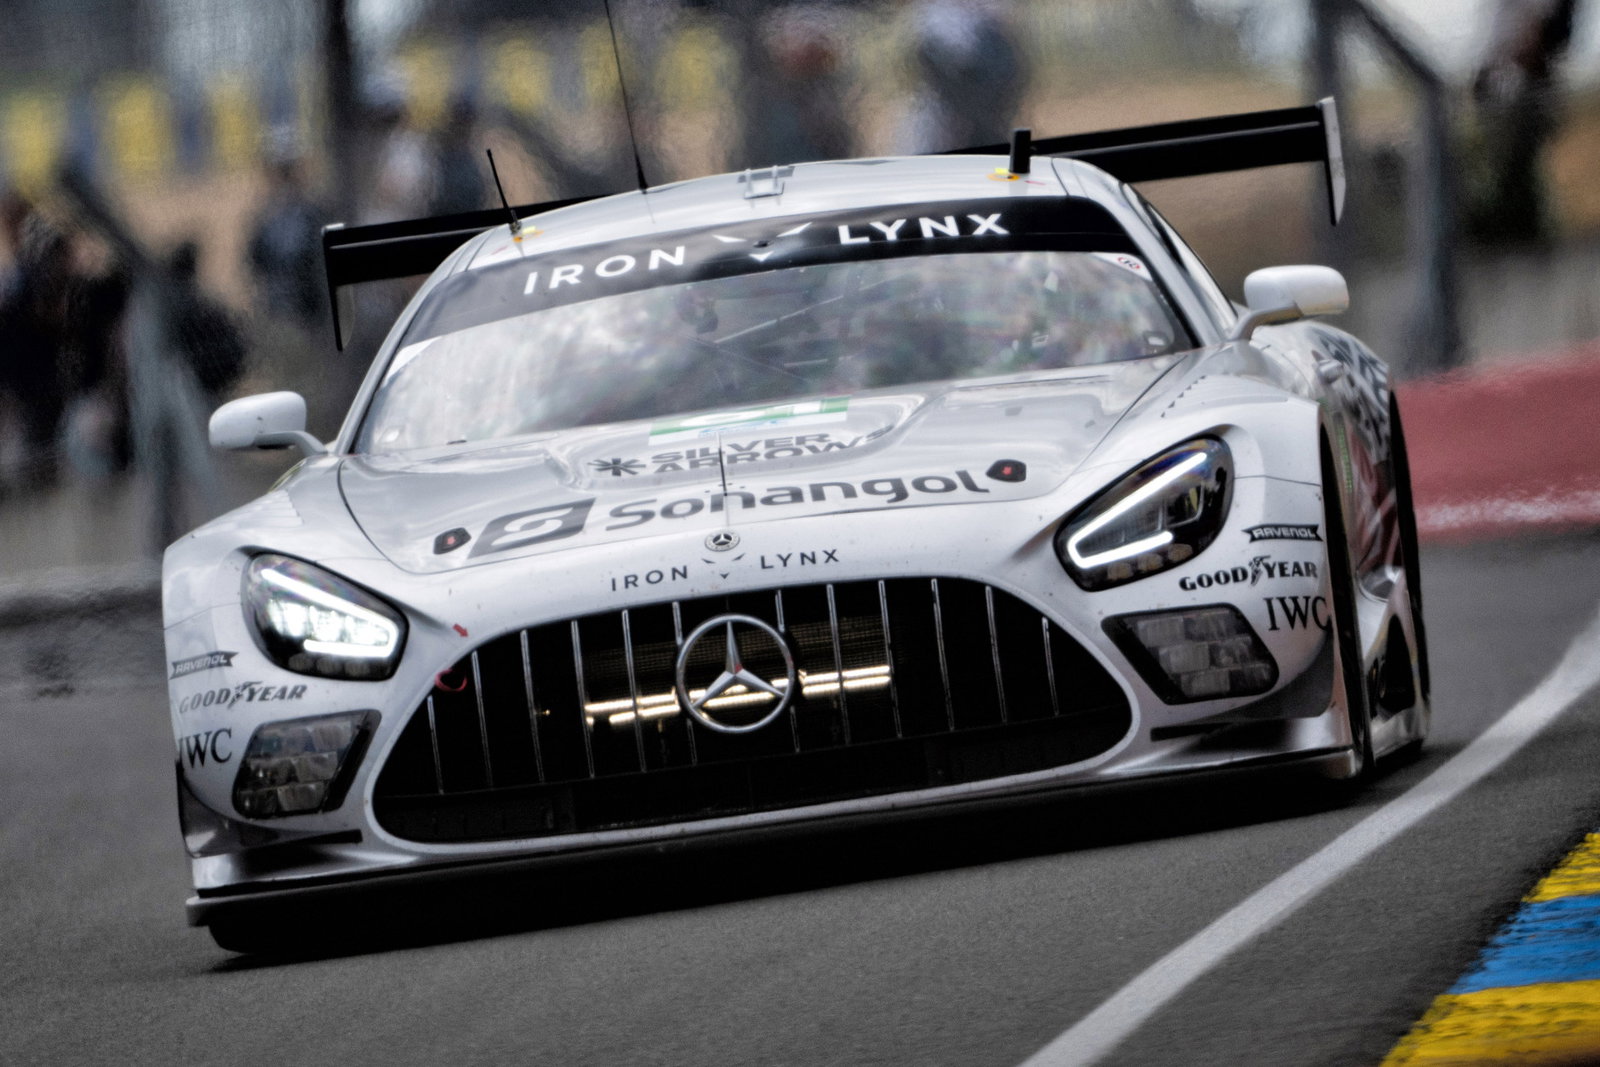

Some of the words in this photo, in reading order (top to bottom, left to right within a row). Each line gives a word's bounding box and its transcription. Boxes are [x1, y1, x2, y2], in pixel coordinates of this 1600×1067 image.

[523, 245, 686, 295] IRON
[838, 213, 1010, 246] LYNX
[651, 432, 832, 464] SILVER
[605, 470, 990, 531] Sonangol
[611, 566, 689, 591] IRON
[760, 548, 840, 570] LYNX
[1263, 596, 1335, 632] IWC
